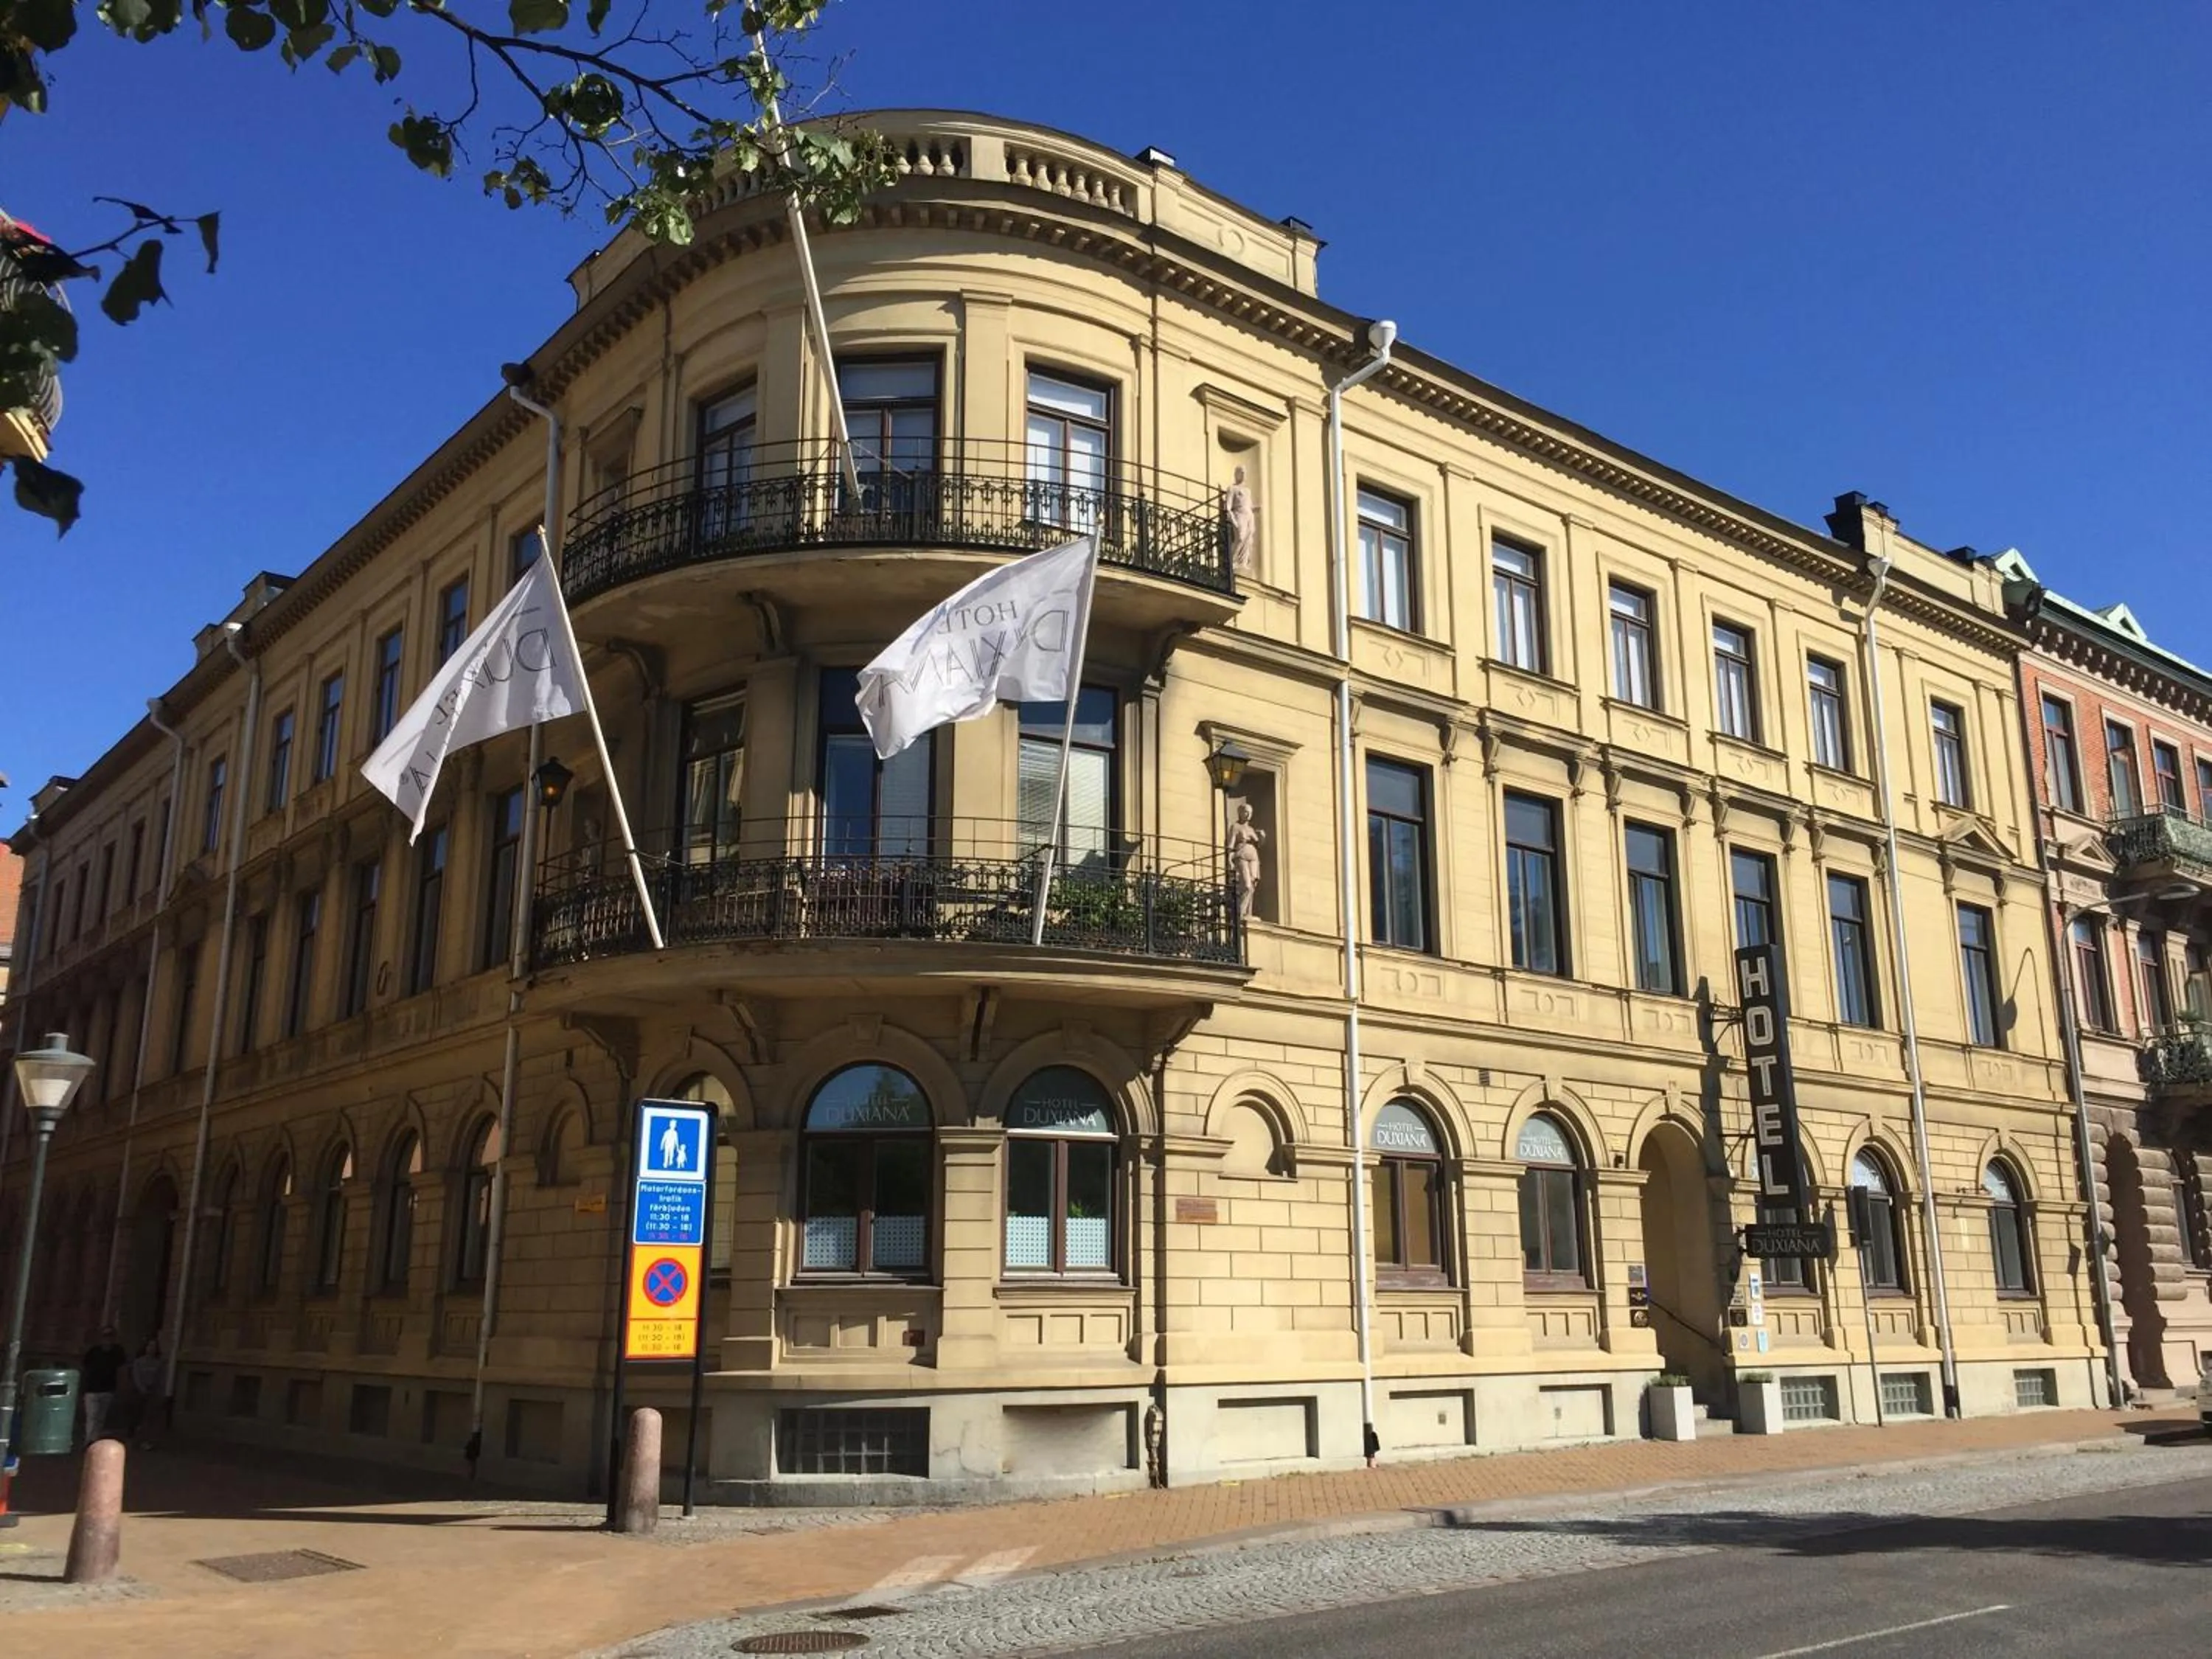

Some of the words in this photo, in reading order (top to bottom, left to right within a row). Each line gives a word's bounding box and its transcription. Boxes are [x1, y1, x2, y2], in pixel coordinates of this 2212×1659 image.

[1741, 957, 1790, 1195] HOTEL
[1042, 1096, 1079, 1110] HOTEL
[827, 1106, 911, 1121] DUXIANA
[1024, 1107, 1097, 1127] DUXIANA
[1377, 1130, 1427, 1147] DUXIANA
[1767, 1228, 1802, 1238] HOTEL
[1752, 1239, 1821, 1253] DUXIANA
